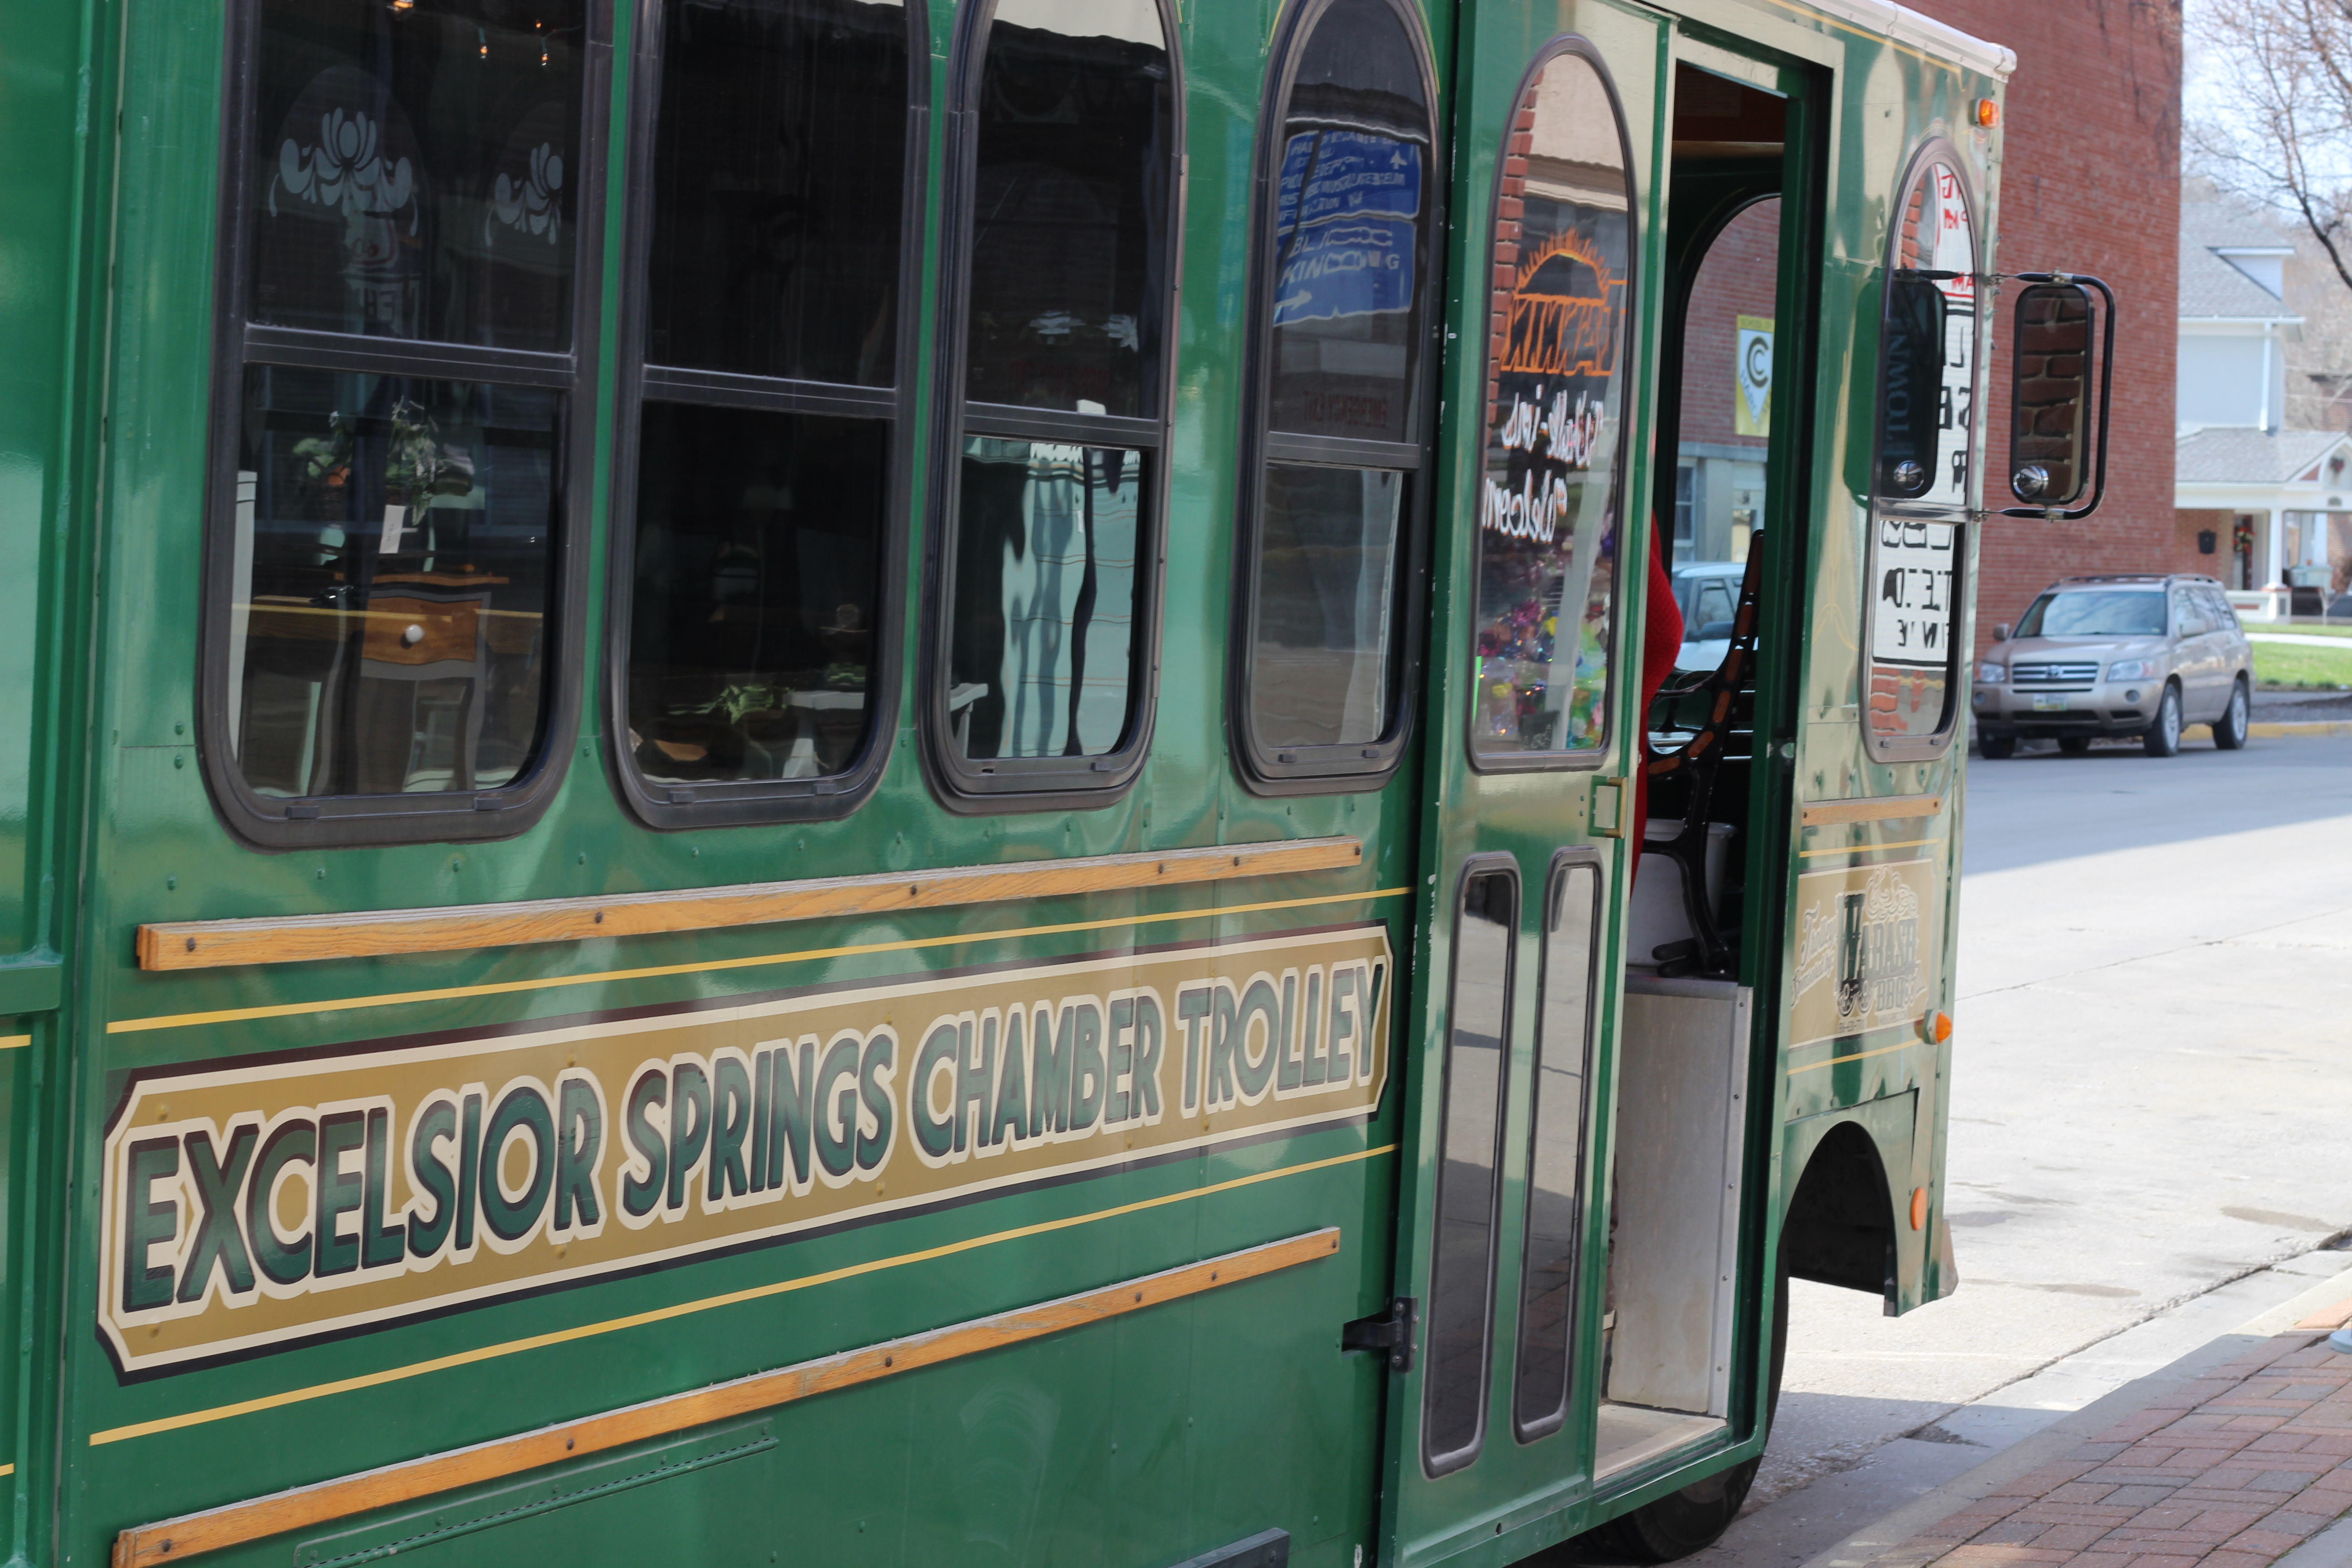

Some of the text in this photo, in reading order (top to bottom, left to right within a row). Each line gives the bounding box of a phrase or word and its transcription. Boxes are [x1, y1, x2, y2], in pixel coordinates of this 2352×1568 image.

[121, 962, 1385, 1314] EXCELSIOR SPRINGS CHAMBER TROLLEY
